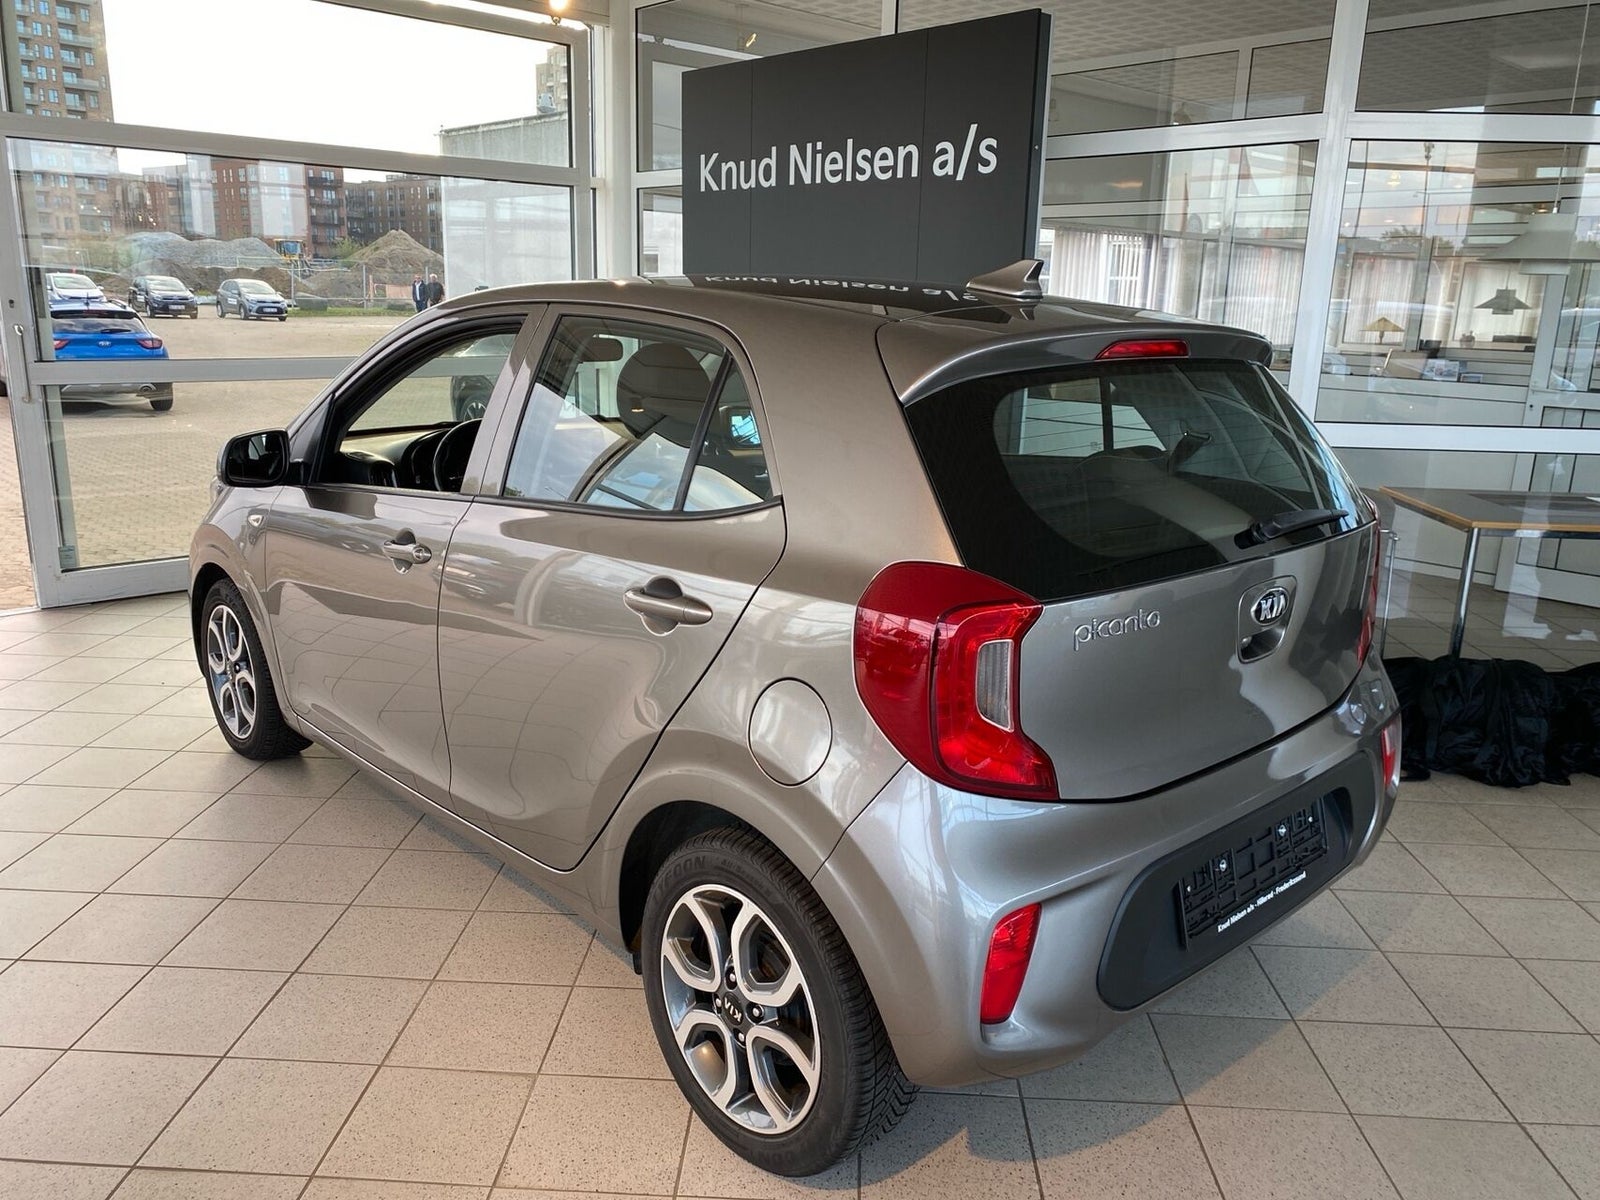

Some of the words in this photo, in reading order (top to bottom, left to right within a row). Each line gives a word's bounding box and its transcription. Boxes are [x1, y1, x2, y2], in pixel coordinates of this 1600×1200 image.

[700, 146, 777, 193] Knud
[789, 138, 919, 186] Nielsen
[932, 123, 998, 181] a/s
[1260, 594, 1286, 621] KIA
[1074, 608, 1161, 652] picanto
[724, 996, 742, 1023] KIA
